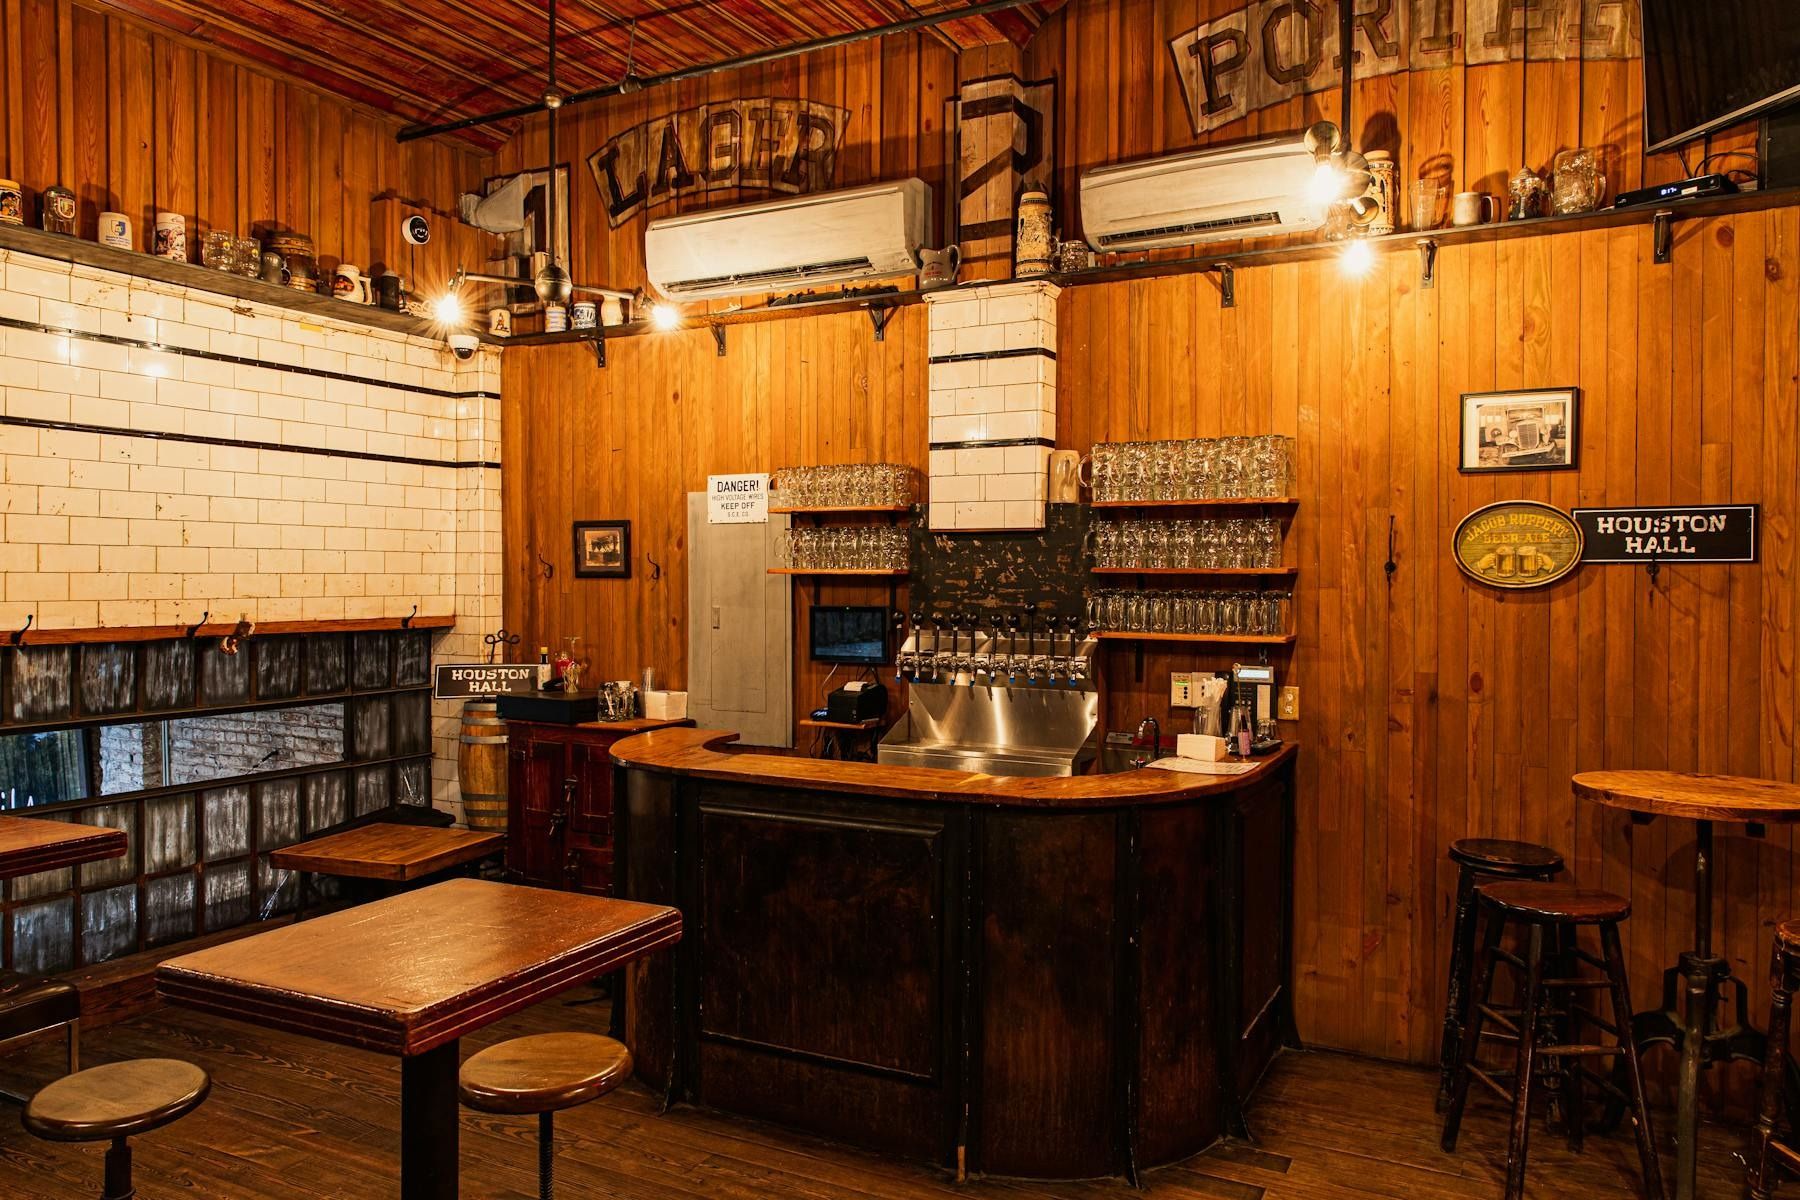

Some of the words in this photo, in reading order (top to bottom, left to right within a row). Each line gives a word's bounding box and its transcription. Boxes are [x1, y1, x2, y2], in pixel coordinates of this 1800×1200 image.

[598, 107, 837, 218] LAGER
[717, 480, 759, 492] DANGER!
[1465, 514, 1506, 542] JACOB
[1509, 513, 1570, 538] RUPPERT
[1597, 514, 1727, 534] HOUSTON
[1483, 533, 1519, 544] BEER
[1524, 532, 1551, 543] ALE
[1625, 536, 1696, 554] HALL
[452, 669, 530, 680] HOUSTON
[468, 681, 512, 692] HALL
